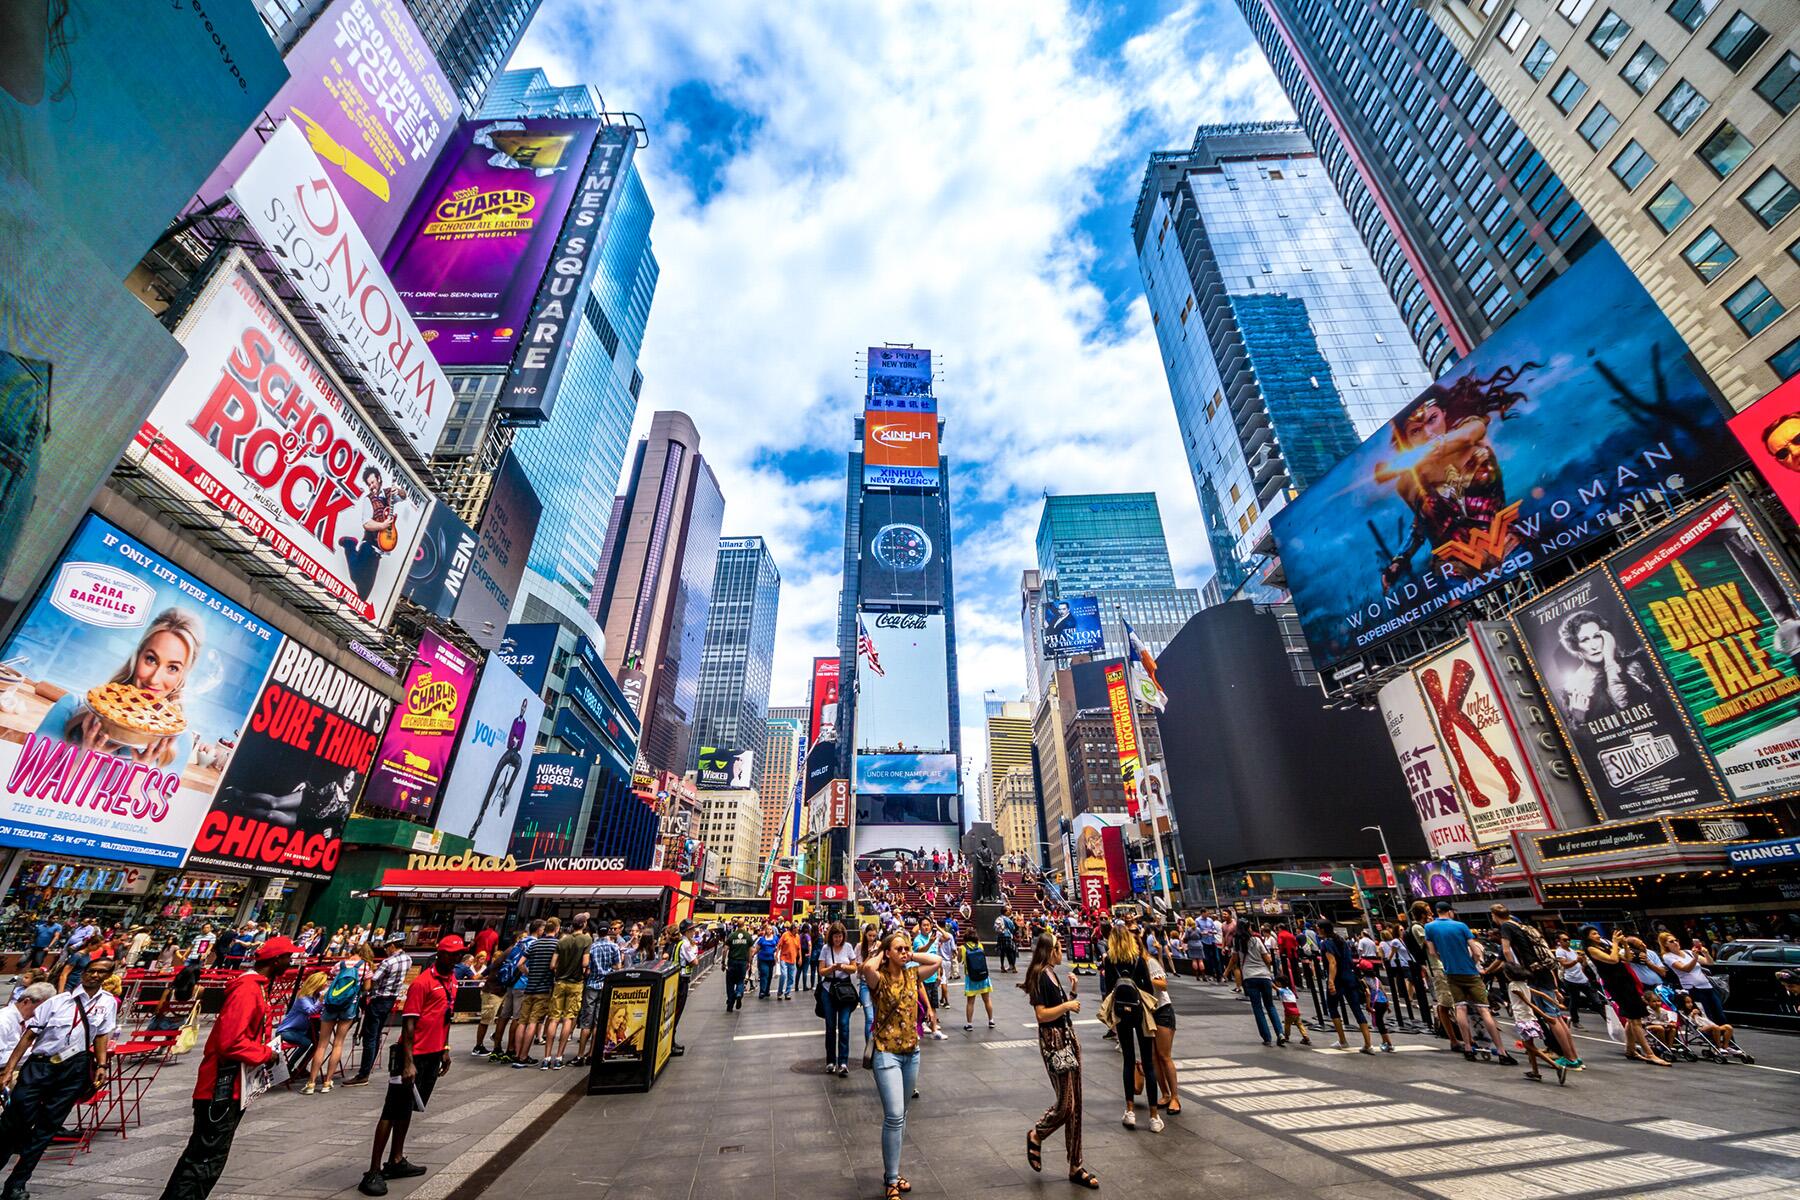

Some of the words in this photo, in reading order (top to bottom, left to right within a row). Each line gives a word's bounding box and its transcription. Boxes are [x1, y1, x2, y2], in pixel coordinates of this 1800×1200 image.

[350, 0, 440, 140] BROADWAY'S
[380, 8, 421, 75] CHOCOLATE
[420, 74, 450, 121] FACTORY
[334, 20, 428, 161] TICKET
[342, 11, 434, 153] GOLDEN
[322, 75, 340, 99] ON
[362, 130, 397, 177] STREET
[330, 57, 343, 75] IS
[343, 77, 369, 112] JUST
[369, 115, 406, 167] AROUND
[336, 78, 357, 108] THE
[356, 108, 394, 162] CORNER
[576, 143, 622, 227] TIMES
[439, 190, 532, 221] CHARLIE
[438, 221, 492, 232] CHOCOLATE
[493, 219, 531, 229] FACTORY
[454, 232, 477, 240] NEW
[477, 231, 518, 239] MUSICAL
[264, 197, 331, 294] GOES
[296, 176, 437, 418] WRONG
[522, 236, 585, 369] SQUARE
[328, 293, 371, 352] THAT
[232, 277, 282, 334] ANDREW
[277, 328, 310, 373] LLOYD
[307, 369, 342, 413] WEBBER
[341, 406, 358, 432] HAS
[356, 424, 395, 475] BROADWAY
[367, 349, 406, 405] PLAY
[881, 360, 898, 369] NEW
[898, 361, 918, 369] YORK
[513, 386, 537, 394] NYC
[228, 327, 367, 500] SCHOOL
[406, 396, 429, 436] THE
[279, 430, 316, 465] of
[879, 430, 931, 441] XINHUA
[187, 366, 355, 553] ROCK
[880, 468, 925, 479] XINHUA
[869, 474, 896, 484] NEWS
[896, 476, 936, 486] AGENCY
[1514, 441, 1674, 539] WOMAN
[252, 493, 283, 518] MUSICAL
[493, 502, 509, 526] YOU
[194, 471, 220, 499] JUST
[219, 494, 229, 507] 4
[230, 500, 262, 537] BLOCKS
[263, 523, 276, 542] TO
[275, 533, 290, 556] THE
[289, 542, 317, 577] WINTER
[315, 565, 344, 597] GARDEN
[343, 586, 369, 615] THEATRE
[488, 514, 499, 534] TO
[498, 528, 512, 553] THE
[1661, 541, 1683, 559] Times
[1679, 515, 1713, 545] CRITICS'
[1710, 500, 1734, 525] PICK
[444, 532, 476, 598] NEW
[477, 544, 490, 562] OF
[483, 529, 509, 568] POWER
[91, 582, 124, 600] SARA
[102, 533, 119, 547] IF
[119, 544, 153, 569] ONLY
[152, 563, 177, 585] LIFE
[177, 578, 208, 604] WERE
[207, 597, 221, 611] AS
[220, 604, 246, 626] EASY
[244, 619, 258, 633] AS
[256, 626, 272, 641] PIE
[1356, 605, 1422, 647] EXPERIENCE
[1420, 602, 1434, 617] IT
[1432, 592, 1452, 611] IN
[1449, 567, 1501, 602] IMAX
[1502, 549, 1534, 576] 3D
[1541, 521, 1588, 555] NOW
[1669, 557, 1699, 592] A
[69, 588, 136, 615] BAREILLES
[1345, 560, 1456, 630] WONDER
[1648, 580, 1763, 652] BRONX
[1043, 629, 1102, 645] PHANTOM
[1073, 638, 1098, 646] OPERA
[1689, 629, 1784, 700] TALE
[273, 639, 392, 735] BROADWAY'S
[409, 685, 456, 712] CHARLIE
[1108, 687, 1118, 714] SUMMER
[1493, 629, 1569, 779] PALACE
[251, 683, 323, 752] SURE
[314, 711, 380, 777] THING
[471, 719, 497, 747] you
[1112, 711, 1126, 752] BROADWAY'S
[1115, 684, 1137, 751] BLOCKBUSTER!
[1476, 707, 1503, 730] Boots
[1588, 714, 1620, 735] GLENN
[1620, 702, 1654, 725] CLOSE
[1596, 733, 1617, 743] ANDREW
[1616, 729, 1634, 738] LLOYD
[1633, 720, 1659, 733] WEBBER'S
[6, 732, 181, 823] WAITRESS
[537, 764, 573, 775] Nikkei
[702, 769, 729, 781] WICKED
[866, 770, 889, 778] UNDER
[889, 769, 904, 778] ONE
[904, 769, 942, 778] NAMEPLATE
[1609, 742, 1658, 779] SUNSET
[1724, 762, 1755, 776] JERSEY
[1755, 755, 1782, 769] BOYS
[1780, 754, 1790, 763] &
[535, 775, 585, 790] 19883.52
[1619, 801, 1642, 810] STRICTLY
[1641, 797, 1662, 806] LIMITED
[1661, 789, 1699, 801] ENGAGEMENT
[11, 802, 33, 815] THE
[35, 806, 53, 818] HIT
[54, 809, 110, 829] BROADWAY
[110, 820, 149, 835] MUSICAL
[835, 780, 847, 826] HELLO!
[1429, 823, 1471, 850] NETFLIX
[1476, 820, 1501, 830] INCLUDING
[1500, 816, 1516, 825] BEST
[194, 808, 344, 874] CHICAGO
[1557, 843, 1566, 852] As
[1571, 841, 1581, 850] we
[1580, 838, 1599, 849] never
[1612, 831, 1646, 848] goodbye.
[1730, 844, 1795, 862] CHANGE
[407, 848, 519, 873] nuchas
[544, 857, 569, 871] NYC
[568, 857, 625, 871] HOTDOGS
[36, 863, 129, 893] GRAND
[163, 876, 220, 900] SLAM
[776, 874, 790, 906] tkts
[1086, 877, 1103, 909] tkts
[612, 989, 649, 1000] Beautiful
